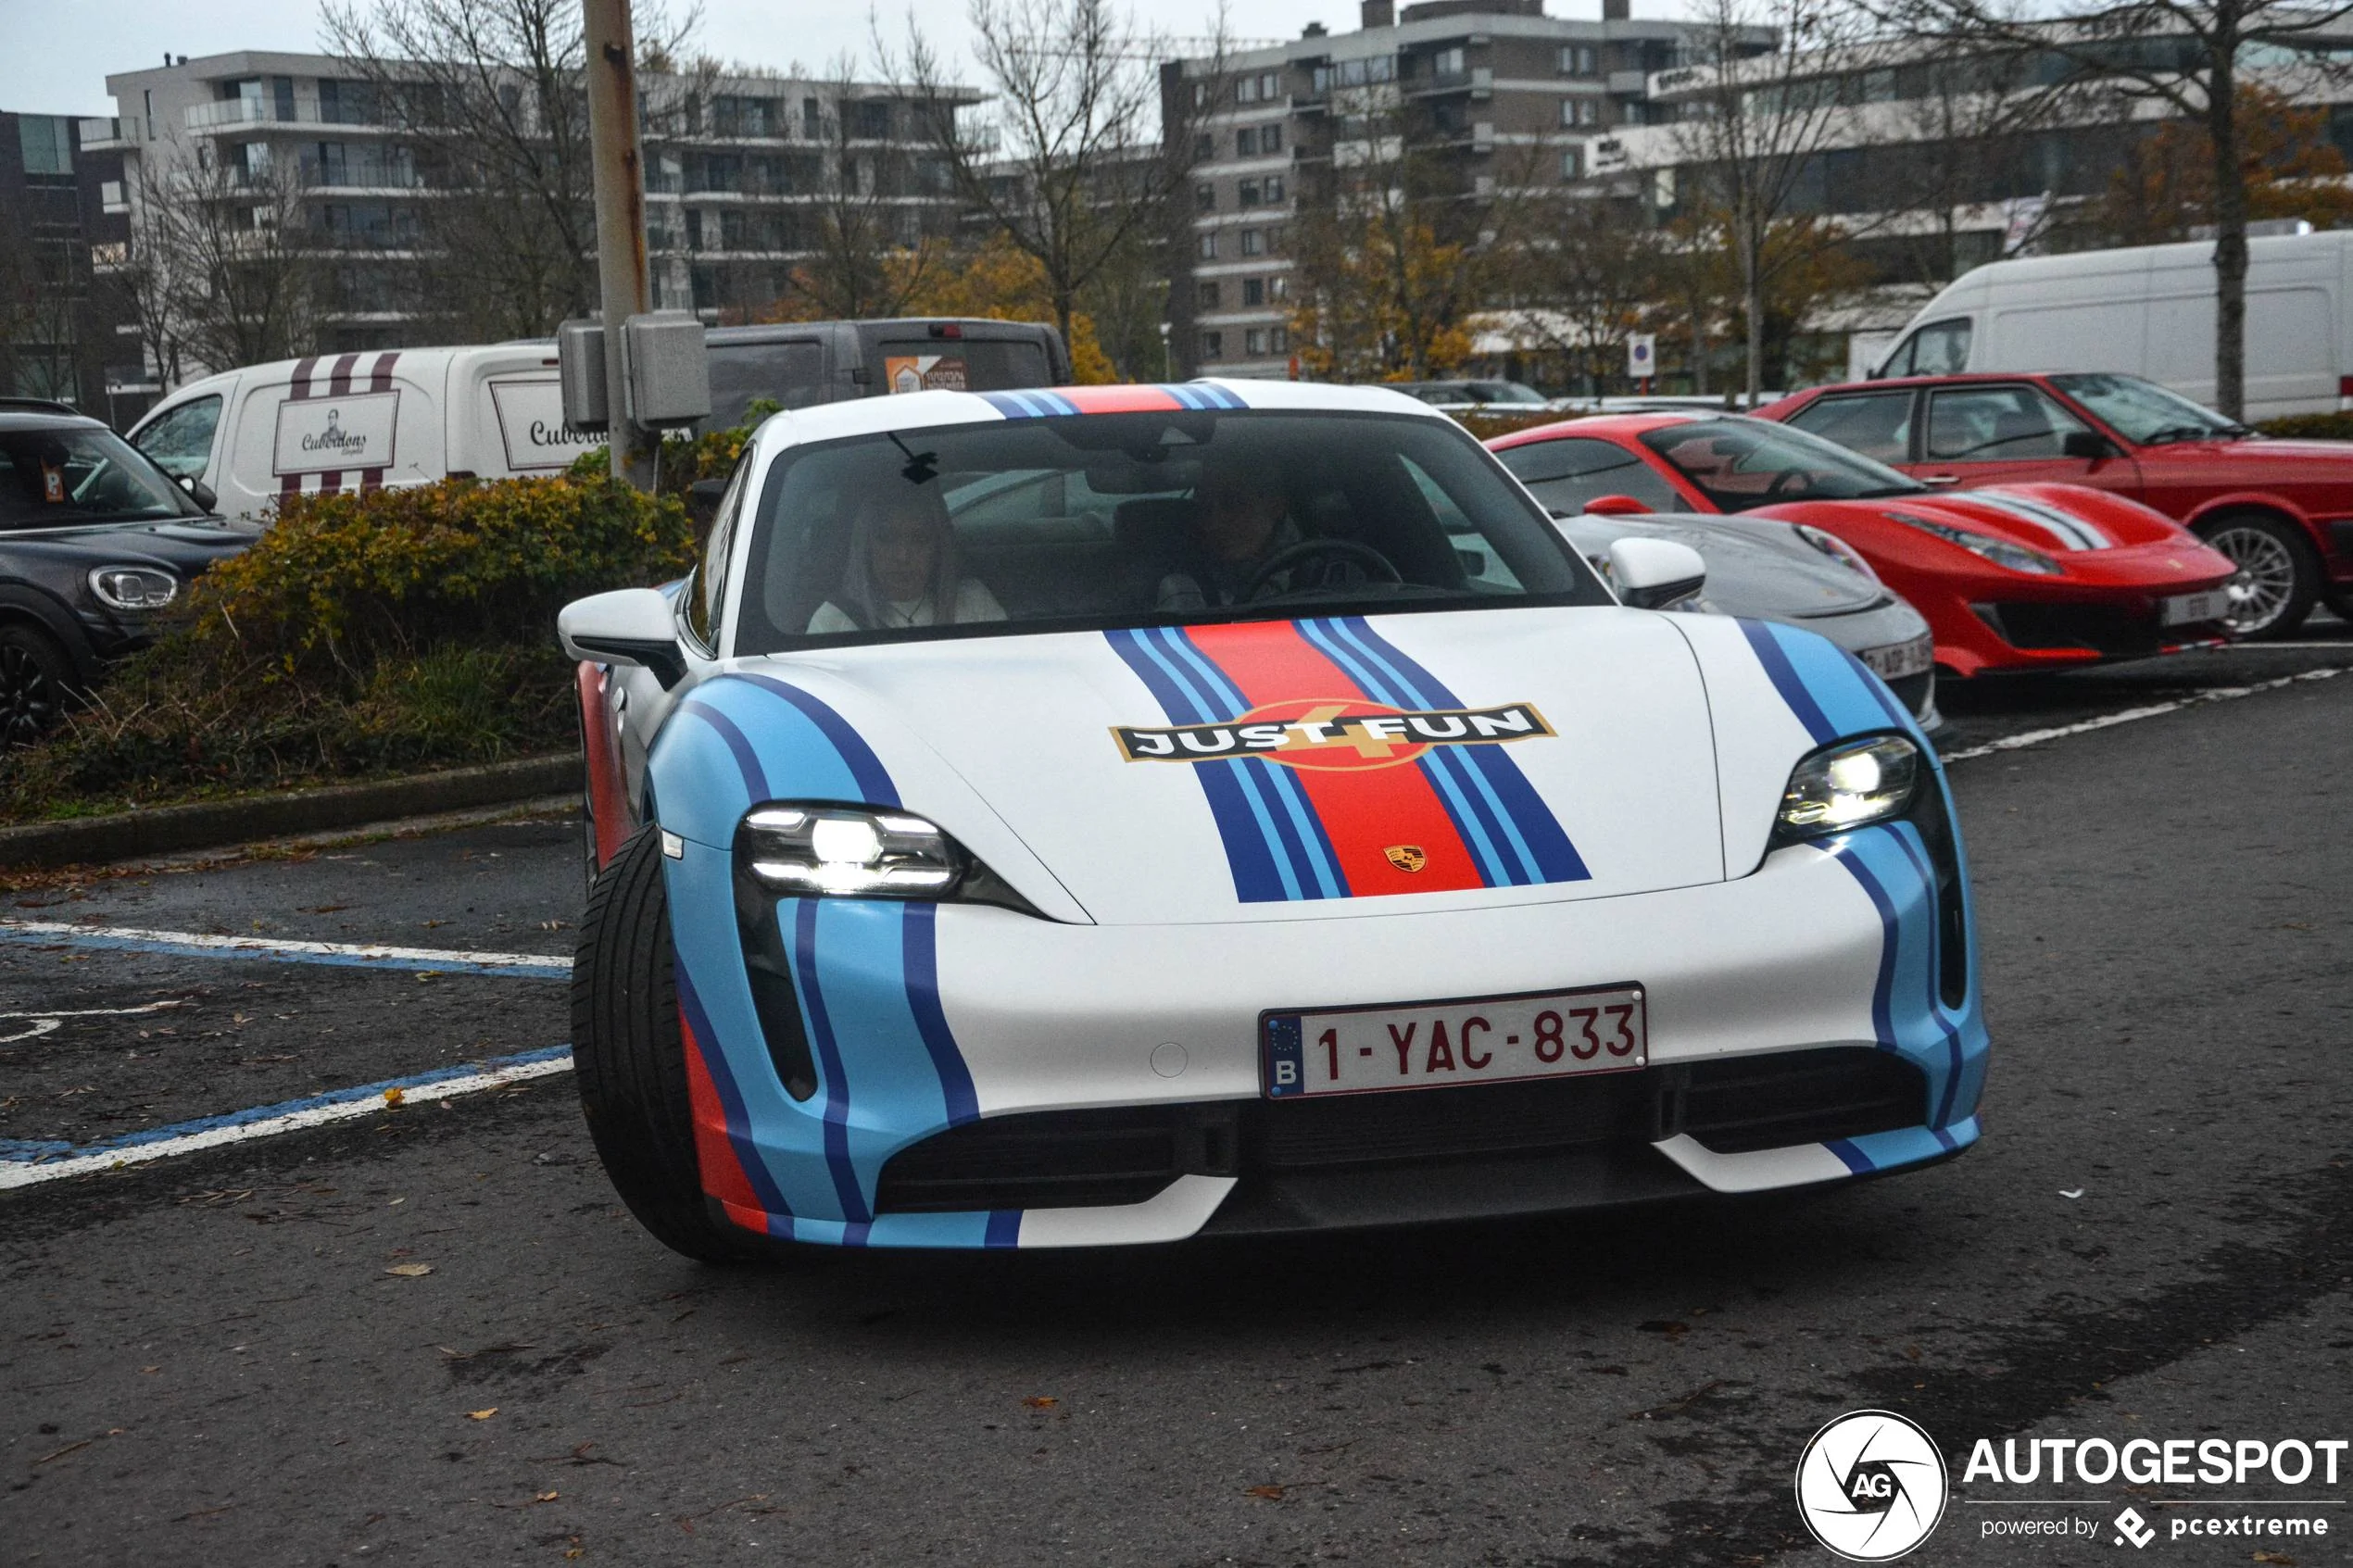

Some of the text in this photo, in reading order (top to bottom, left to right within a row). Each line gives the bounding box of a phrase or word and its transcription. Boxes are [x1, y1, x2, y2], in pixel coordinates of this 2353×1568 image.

[302, 430, 367, 451] Cuberdons
[1136, 721, 1335, 756] JUST
[1359, 709, 1533, 740] FUN
[1318, 1003, 1636, 1081] 1-YAC-833
[1276, 1060, 1297, 1085] B
